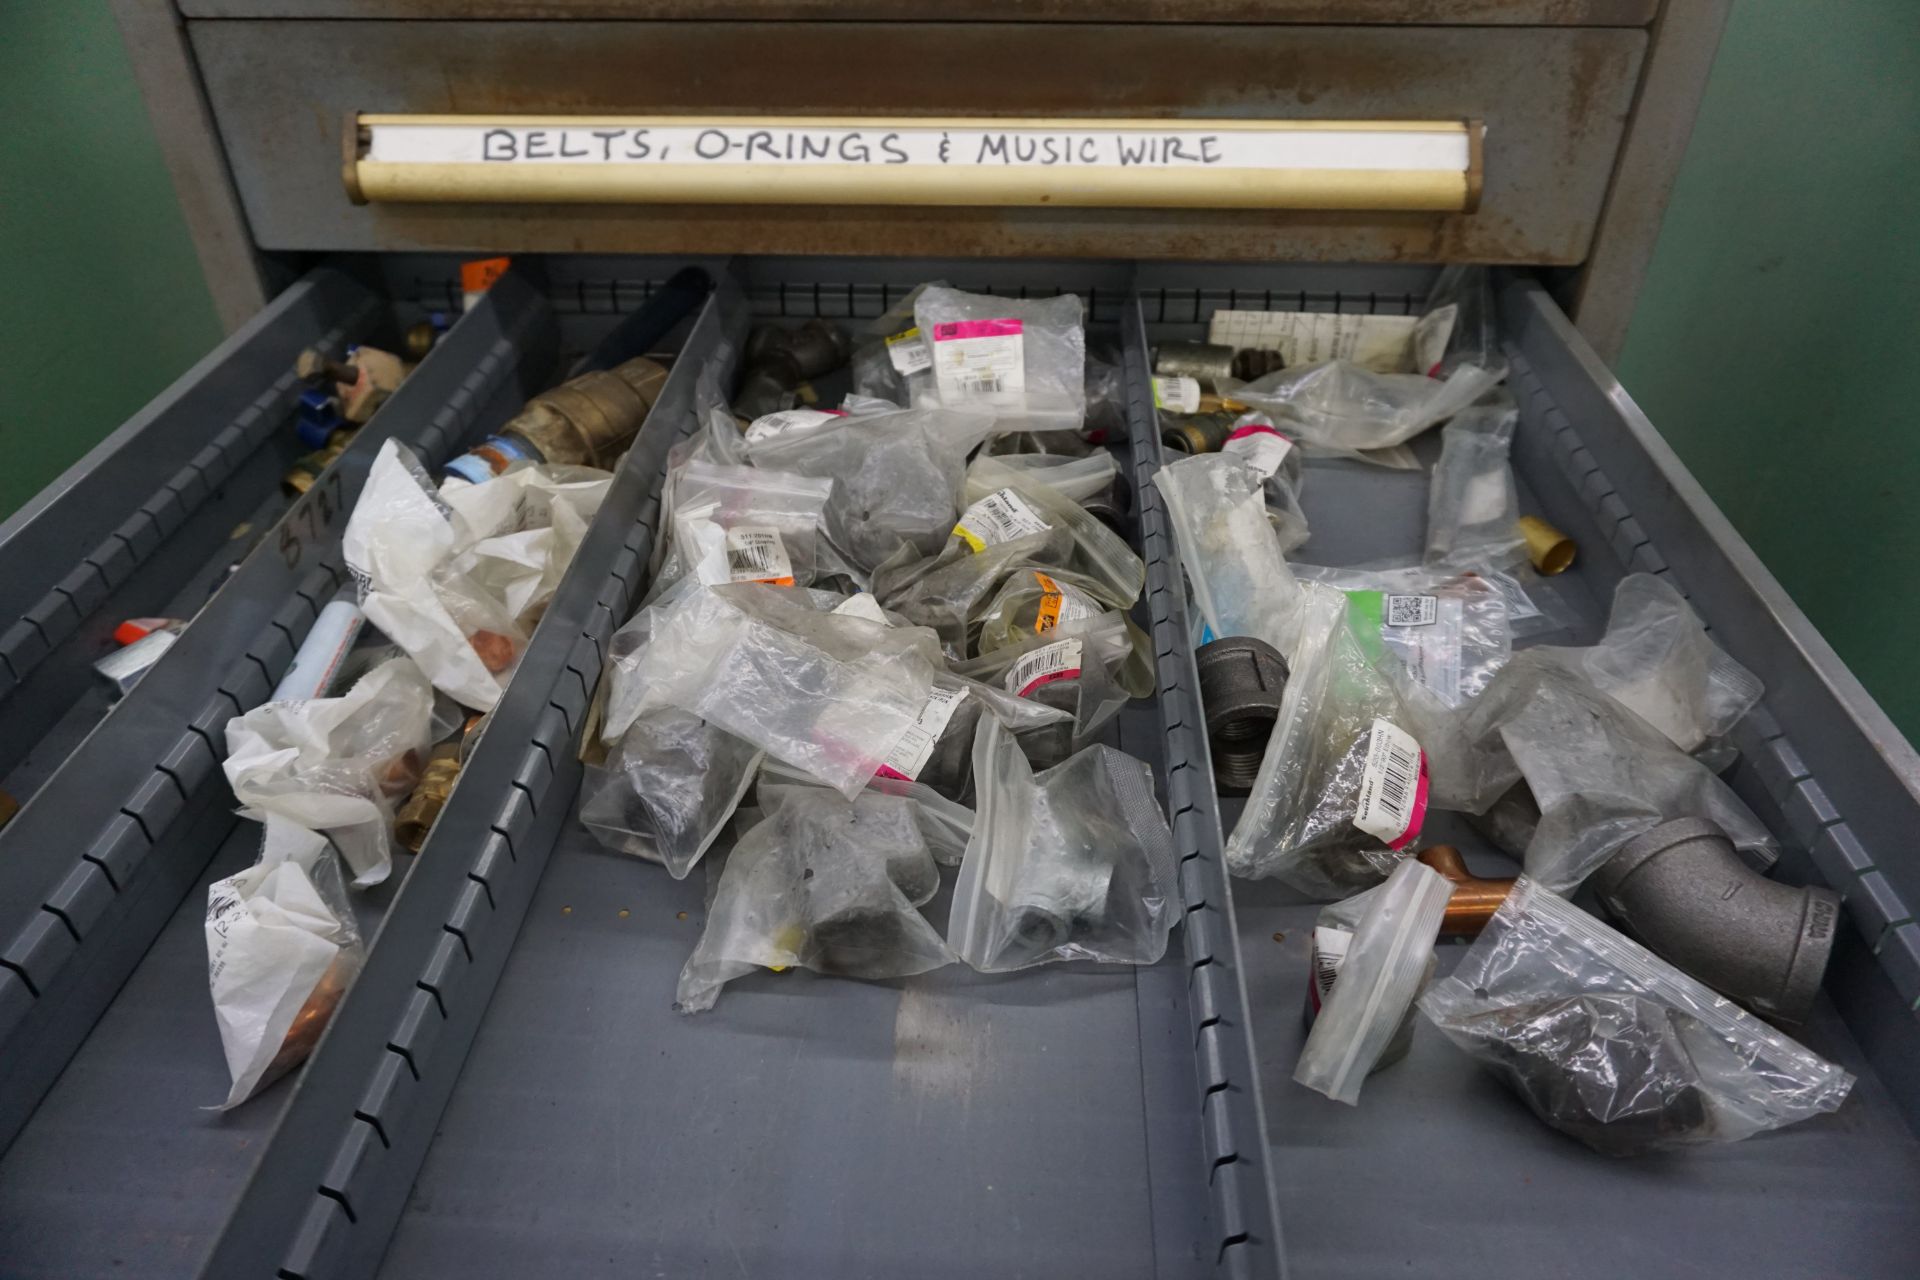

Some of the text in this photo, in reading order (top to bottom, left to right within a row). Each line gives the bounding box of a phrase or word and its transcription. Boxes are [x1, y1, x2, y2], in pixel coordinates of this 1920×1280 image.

[483, 129, 669, 163] BELTS,
[694, 128, 909, 164] O-RINGS
[976, 133, 1096, 165] MUSIC
[1117, 137, 1221, 165] WIRE
[1361, 777, 1375, 821] Southland
